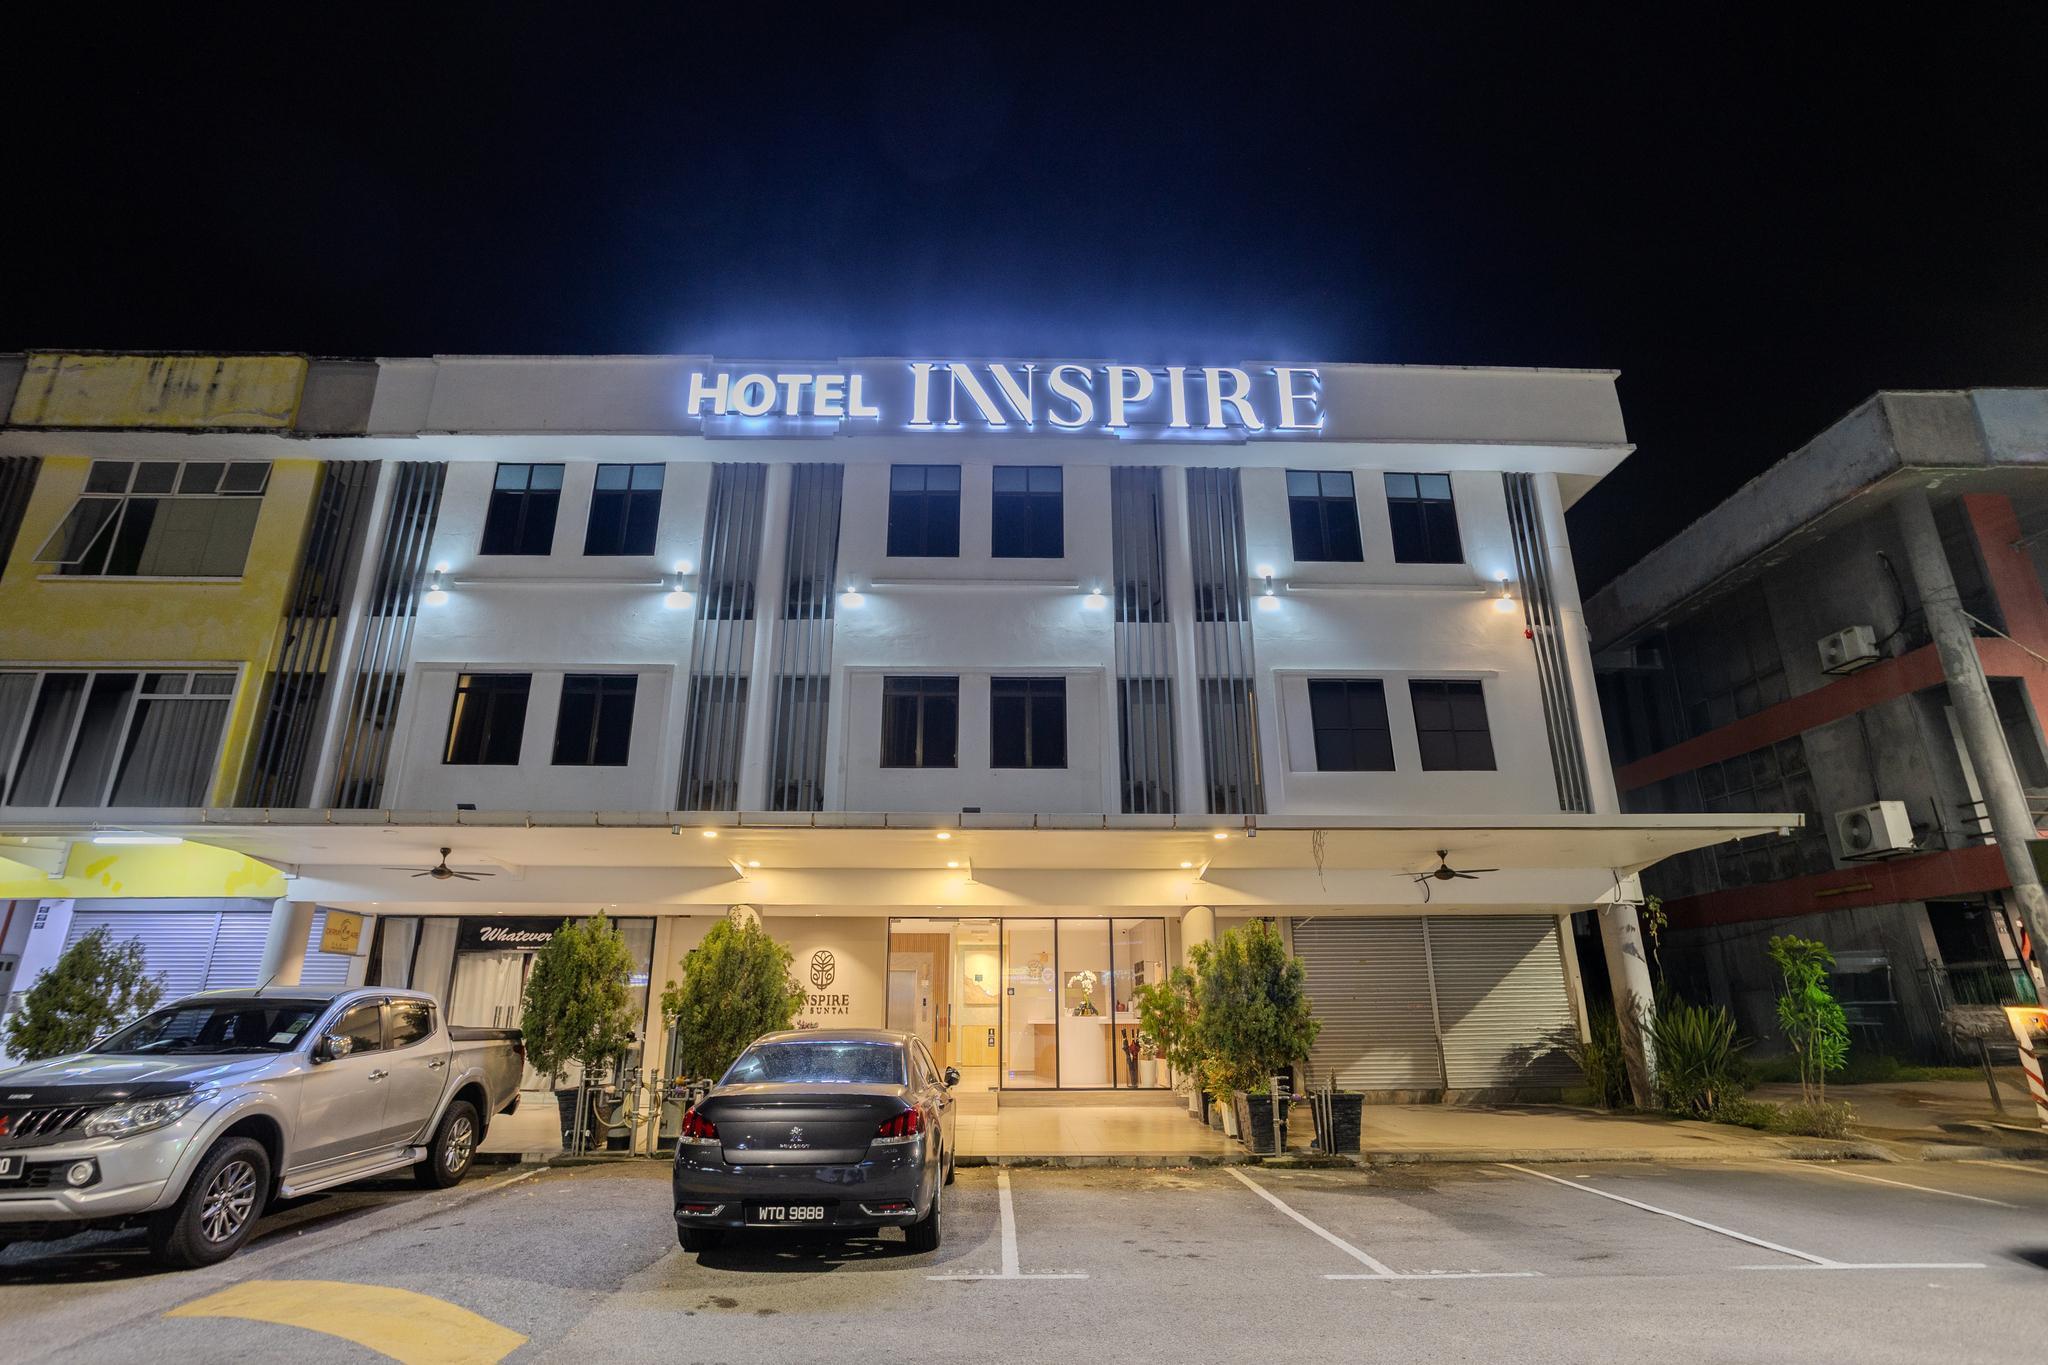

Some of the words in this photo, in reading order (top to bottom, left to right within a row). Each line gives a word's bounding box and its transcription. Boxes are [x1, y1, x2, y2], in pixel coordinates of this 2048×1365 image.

[687, 373, 880, 418] HOTEL
[908, 363, 1326, 431] INNSPIRE
[480, 926, 553, 941] Whatever
[801, 994, 849, 1007] NSPIRE
[809, 1006, 849, 1015] SUNTAI
[0, 1157, 11, 1174] 0
[758, 1206, 785, 1220] WTQ
[788, 1206, 824, 1220] 9888
